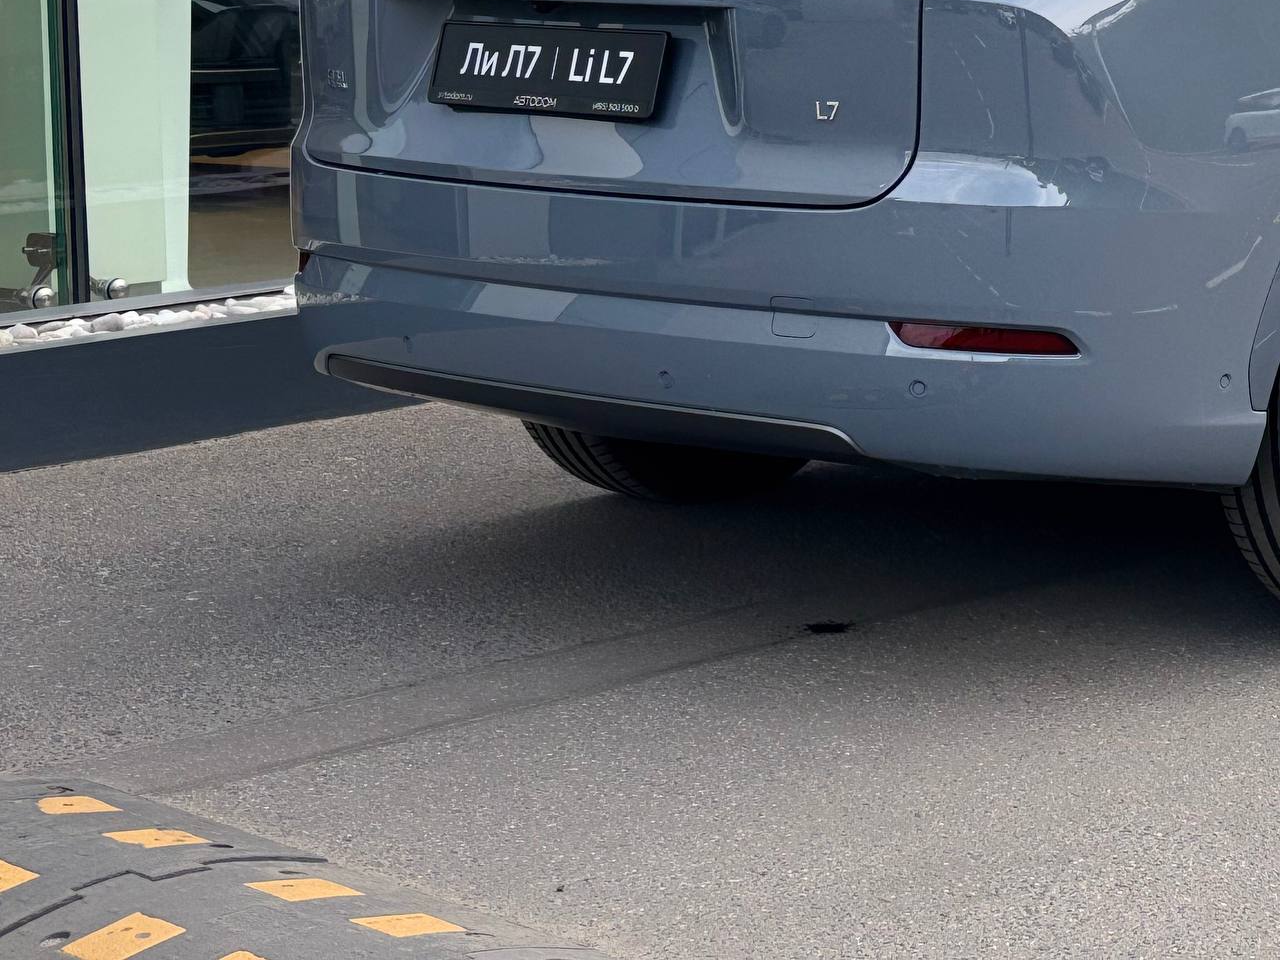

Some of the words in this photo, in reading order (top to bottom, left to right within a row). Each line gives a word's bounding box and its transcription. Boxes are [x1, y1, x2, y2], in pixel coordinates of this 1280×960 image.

[459, 42, 499, 77] Ли
[501, 44, 542, 79] Л7
[568, 47, 595, 83] Li
[598, 49, 635, 85] L7
[815, 100, 840, 121] L7
